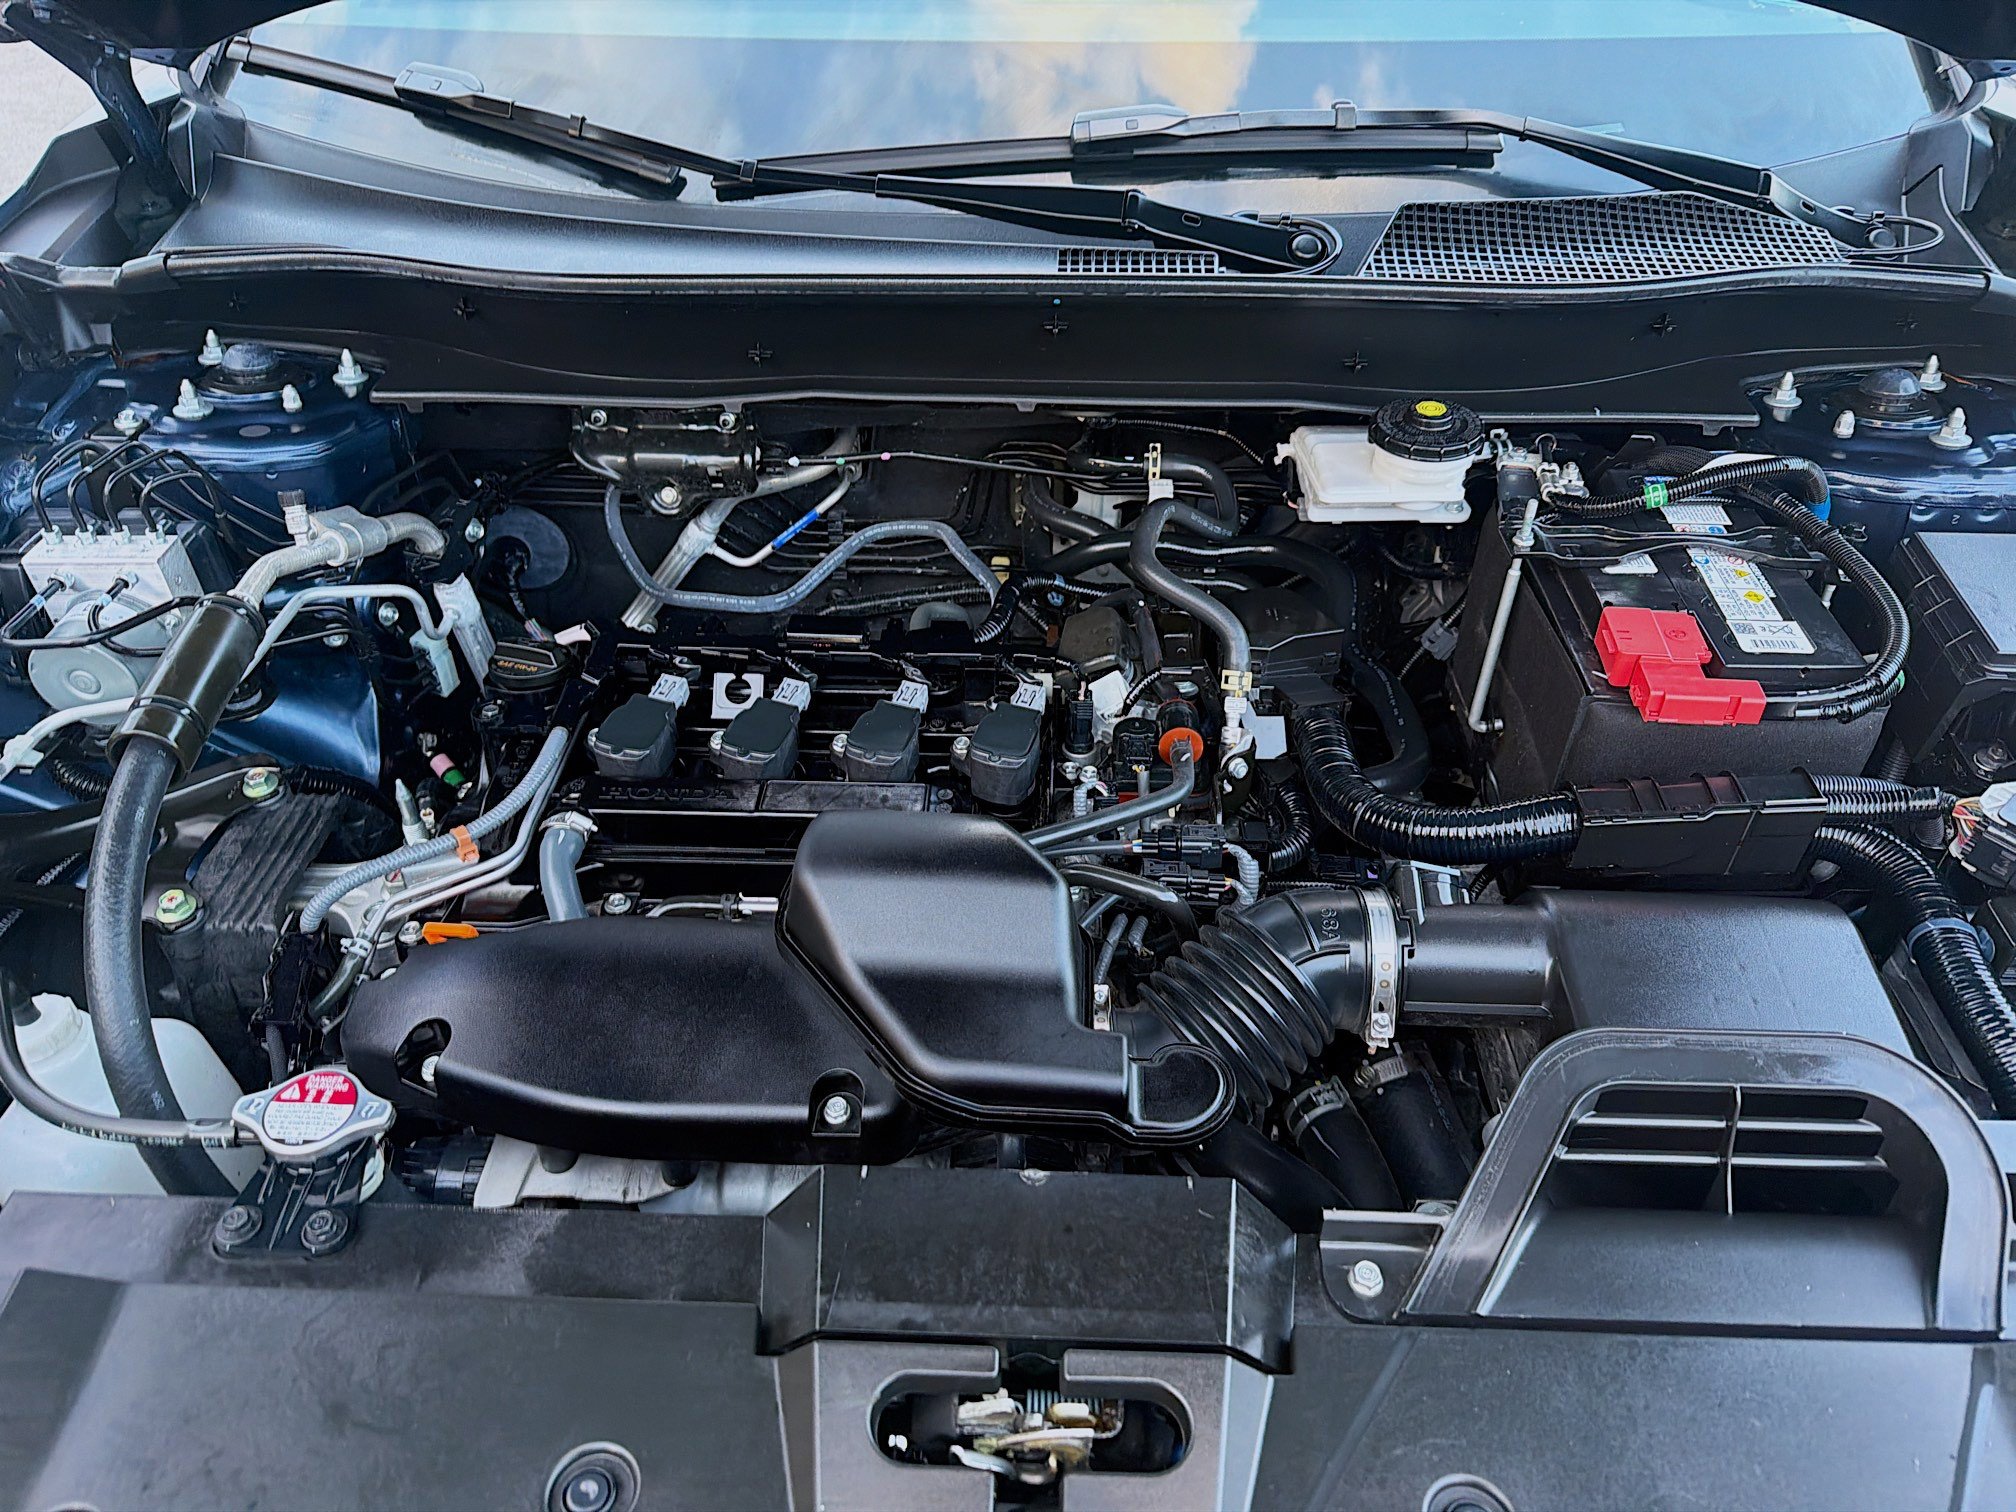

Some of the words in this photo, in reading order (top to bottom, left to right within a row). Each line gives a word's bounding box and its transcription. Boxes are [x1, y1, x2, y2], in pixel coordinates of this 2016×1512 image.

[598, 786, 739, 801] HONDA
[308, 1074, 345, 1084] DANGER
[305, 1081, 349, 1092] WARNING
